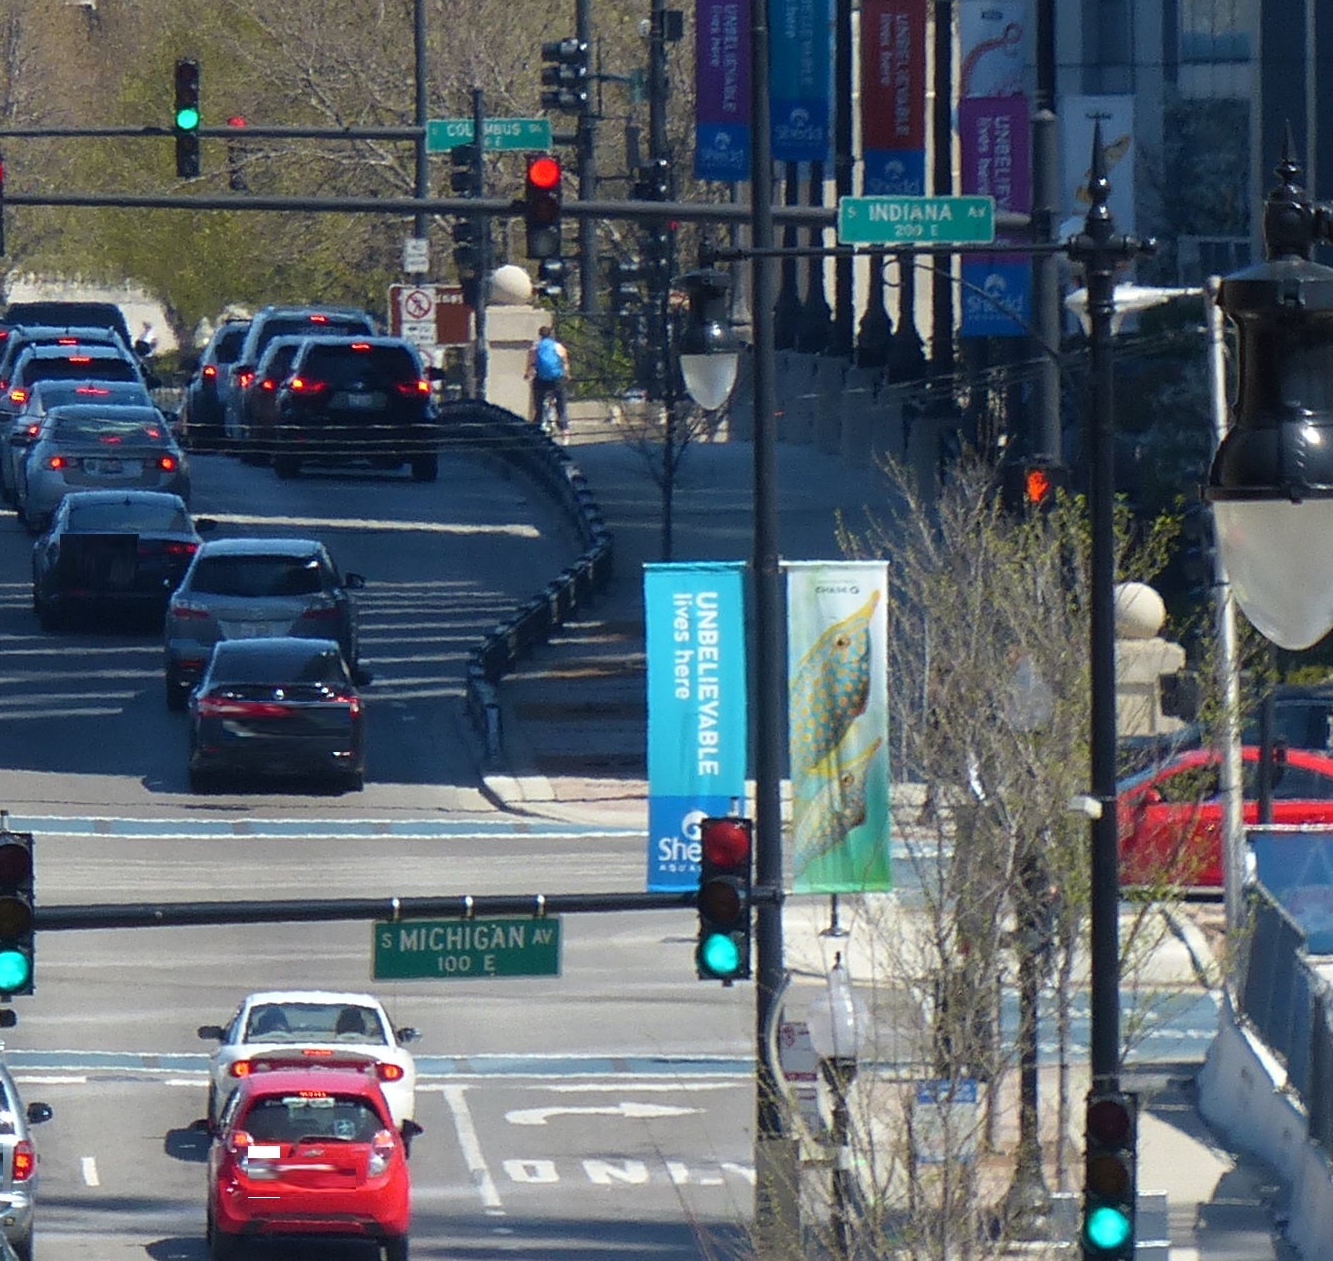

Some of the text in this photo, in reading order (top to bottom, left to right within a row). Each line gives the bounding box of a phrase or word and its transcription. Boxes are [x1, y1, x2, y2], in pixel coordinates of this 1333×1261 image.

[446, 123, 521, 137] COLMBUS
[994, 115, 1012, 213] UNBELIEV
[848, 202, 986, 222] S INDIANA AV
[930, 224, 939, 237] E
[673, 592, 694, 700] lives here
[695, 591, 720, 777] UNBELIEVABLE
[658, 836, 702, 863] She
[659, 864, 702, 873] AQUA
[382, 925, 553, 952] S MICHIGAN AV
[438, 955, 496, 973] 100 E
